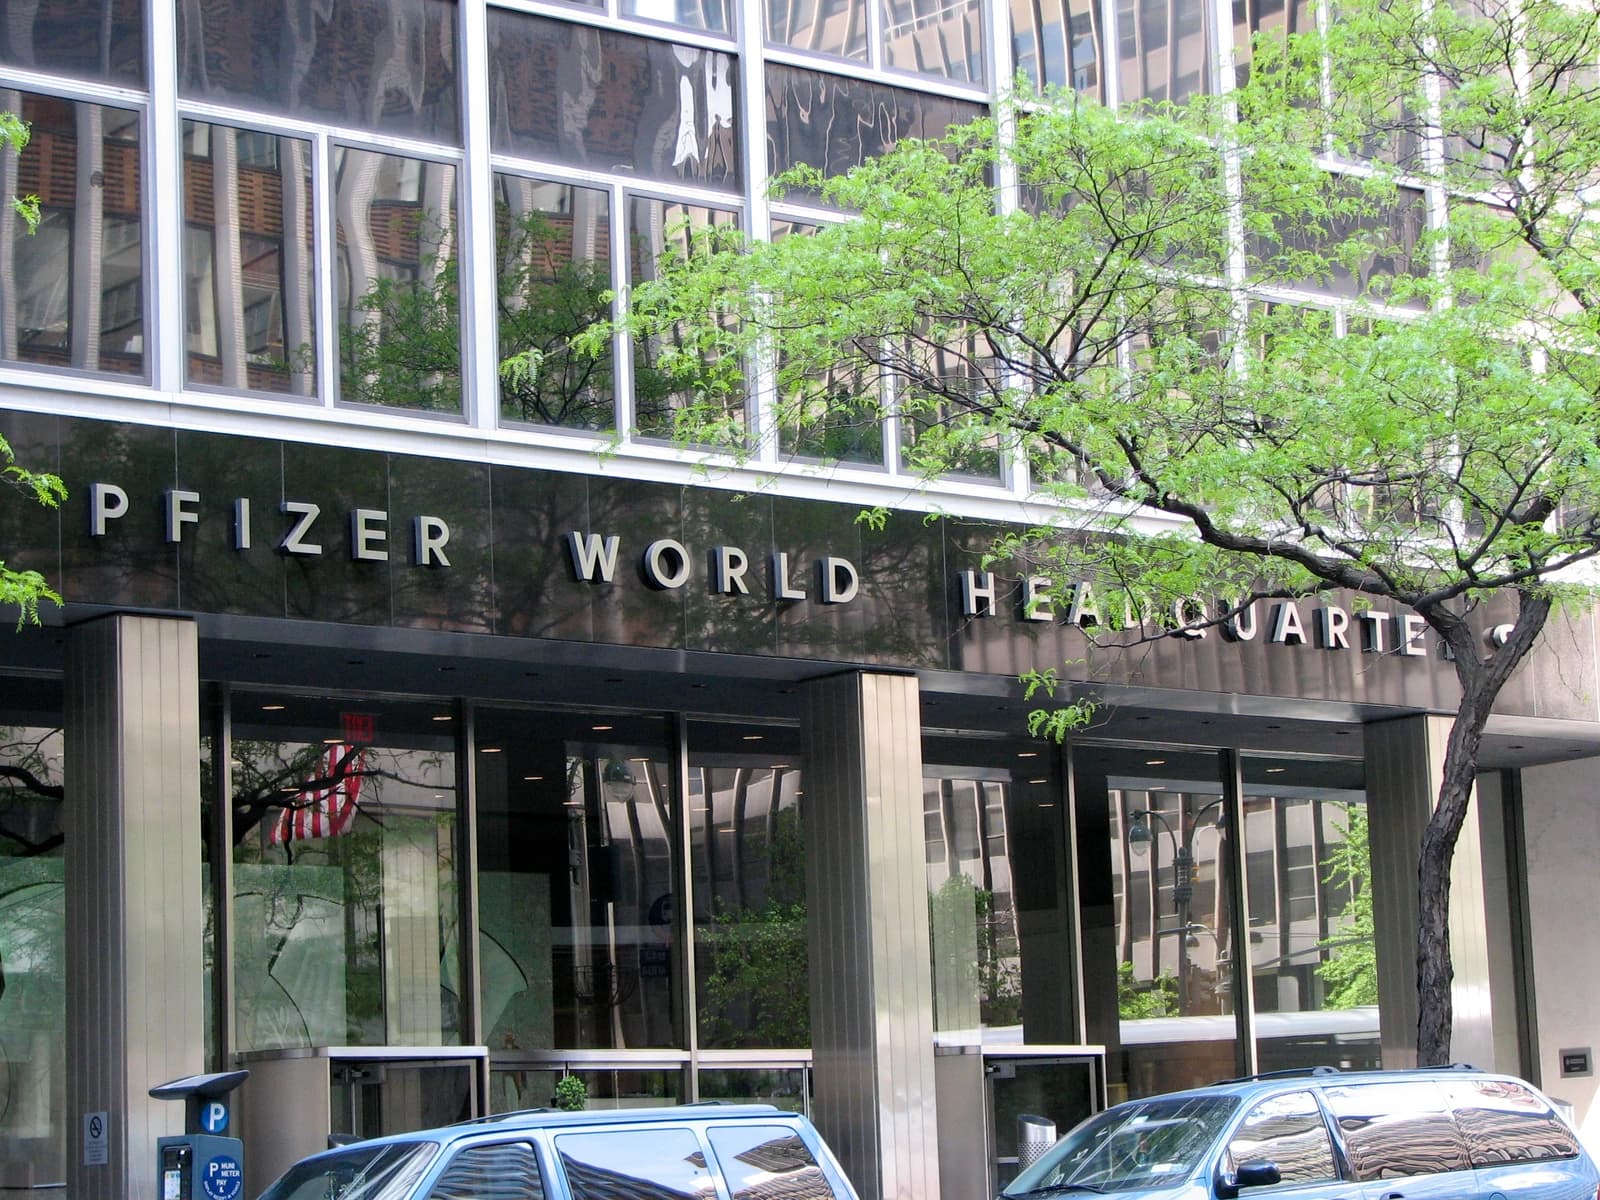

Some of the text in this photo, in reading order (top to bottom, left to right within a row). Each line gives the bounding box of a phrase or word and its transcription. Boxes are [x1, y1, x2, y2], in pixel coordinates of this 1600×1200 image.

[90, 483, 1516, 662] PFIZER WORLD HEADQUARTE
[209, 1102, 225, 1131] P
[209, 1162, 219, 1177] P
